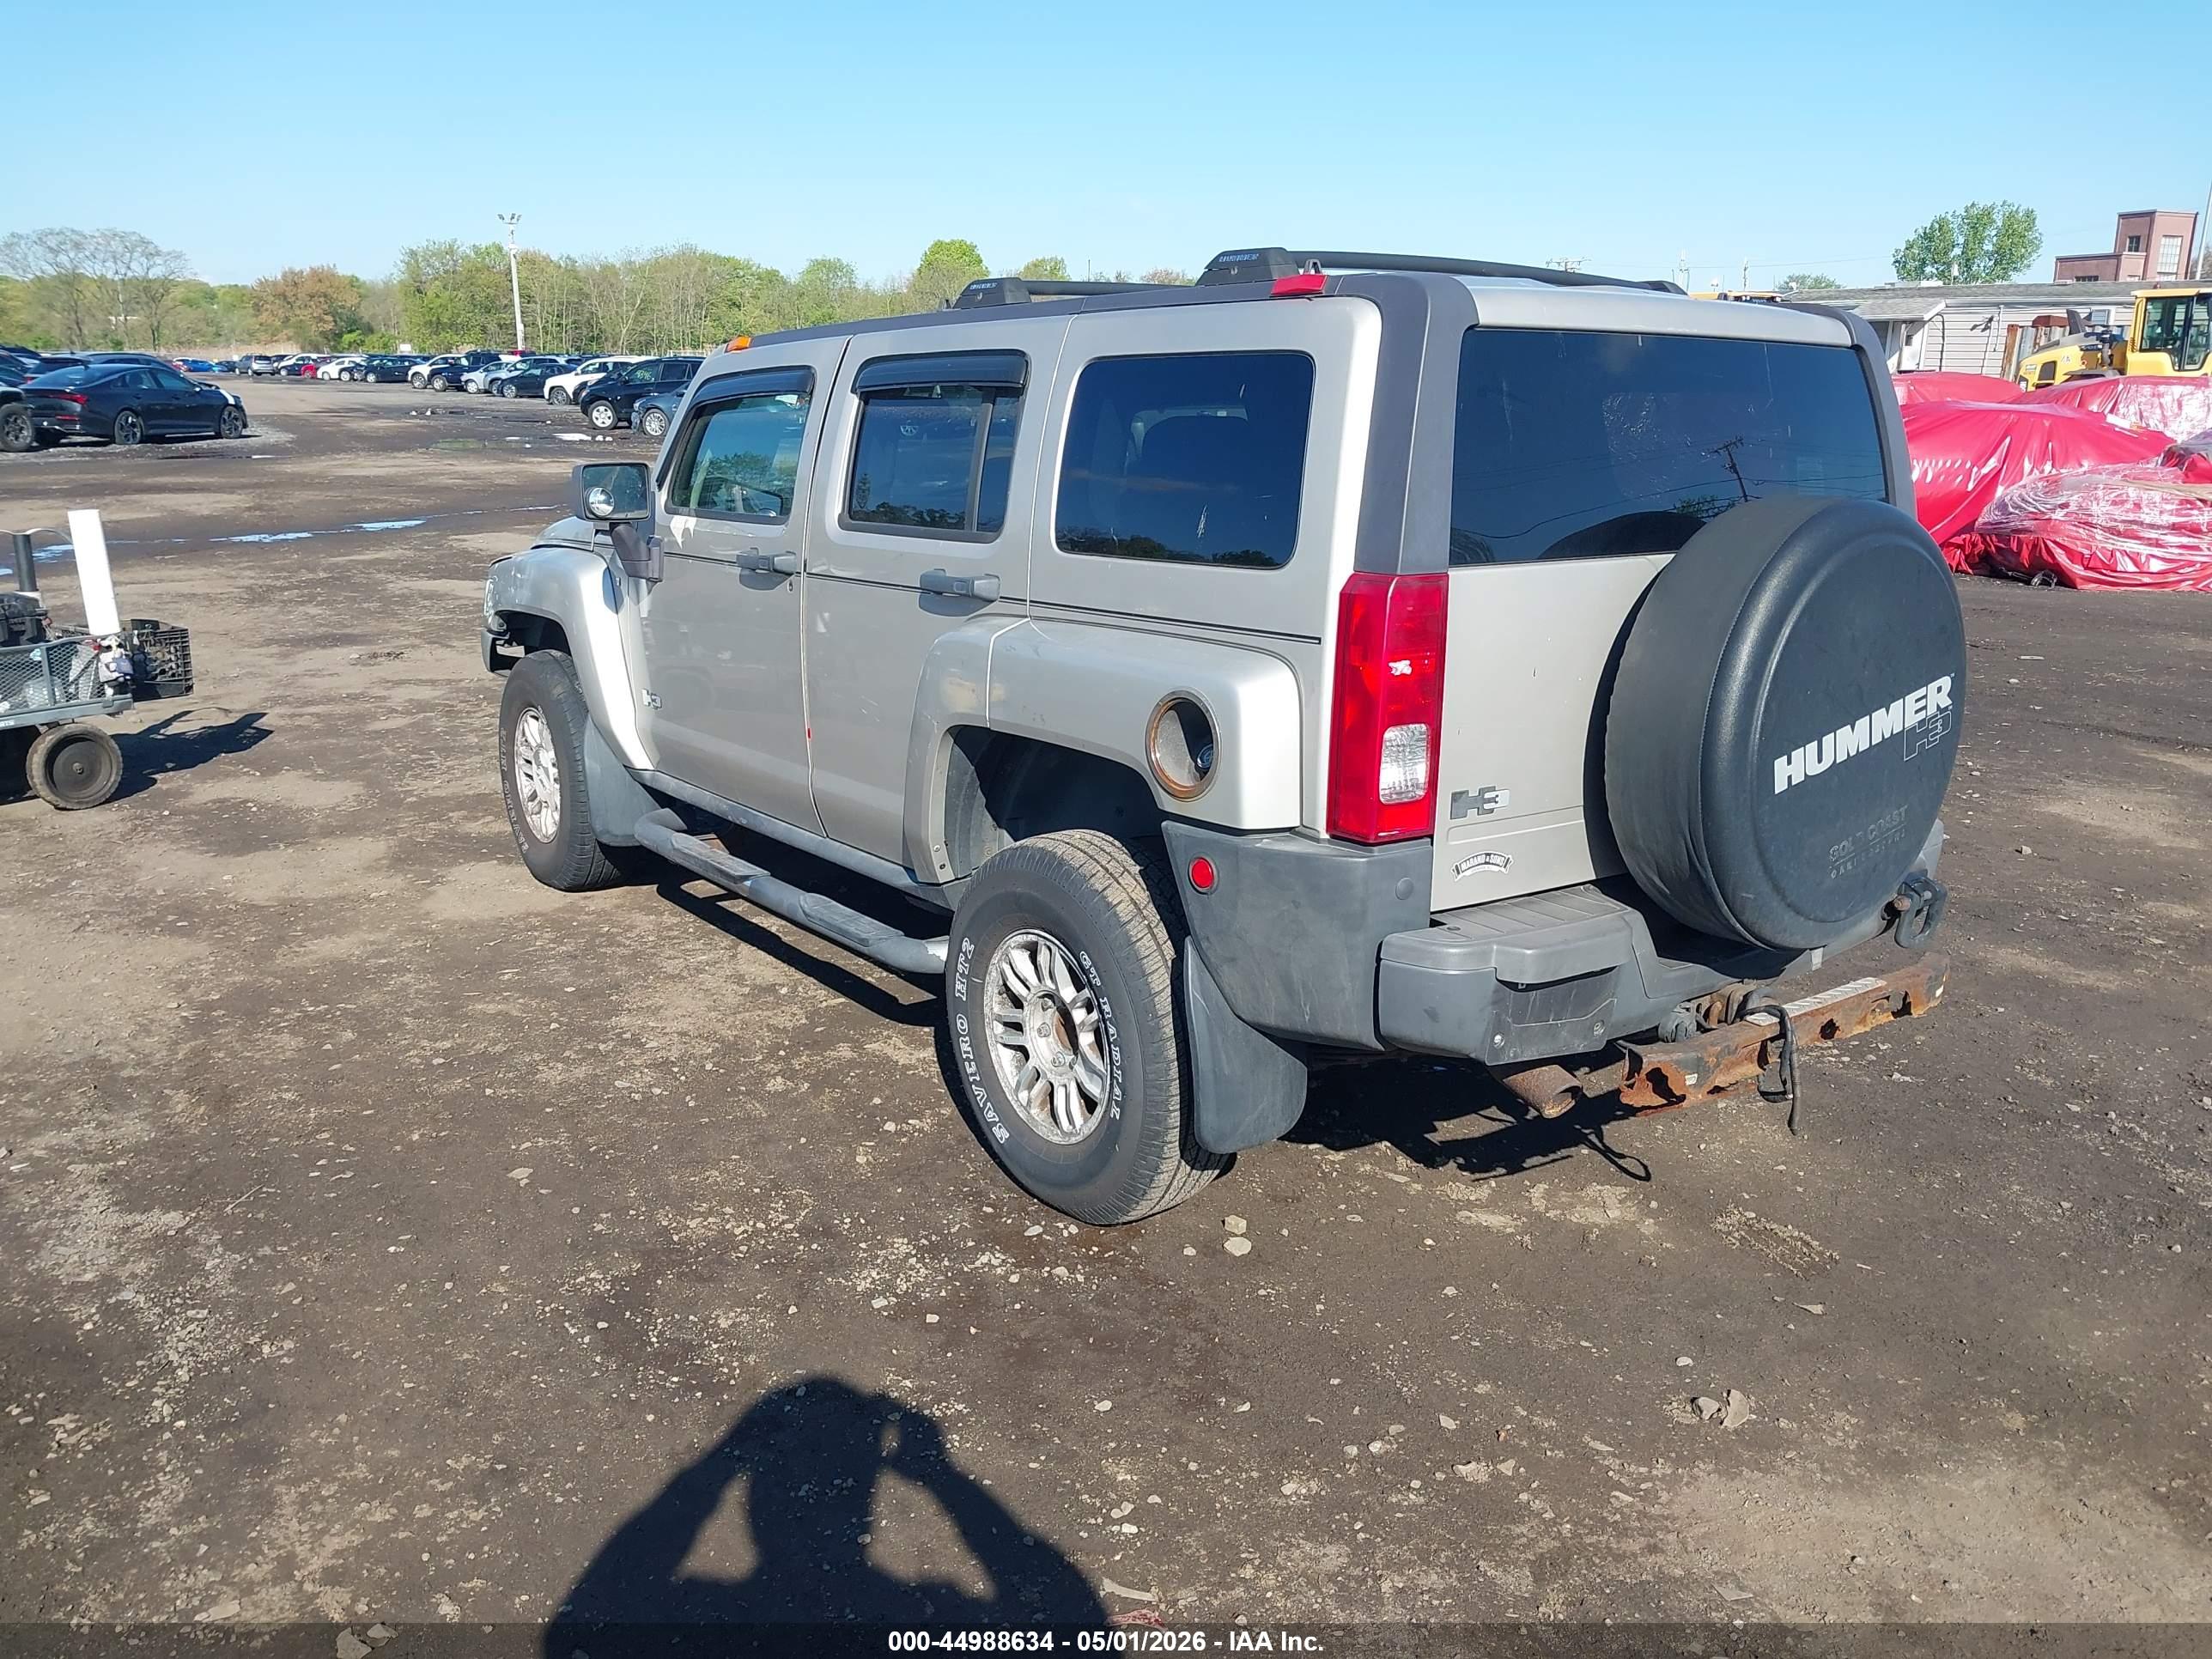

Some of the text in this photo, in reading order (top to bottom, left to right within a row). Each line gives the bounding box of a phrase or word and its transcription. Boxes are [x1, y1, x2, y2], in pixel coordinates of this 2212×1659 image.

[641, 689, 662, 710] H3
[1774, 675, 1953, 795] HUMMER
[1903, 710, 1952, 763] H3
[1449, 786, 1510, 820] H3
[1490, 854, 1505, 866] SONS
[955, 937, 1010, 1144] SAVIERO HT2
[1079, 951, 1122, 1121] GT RADIAL
